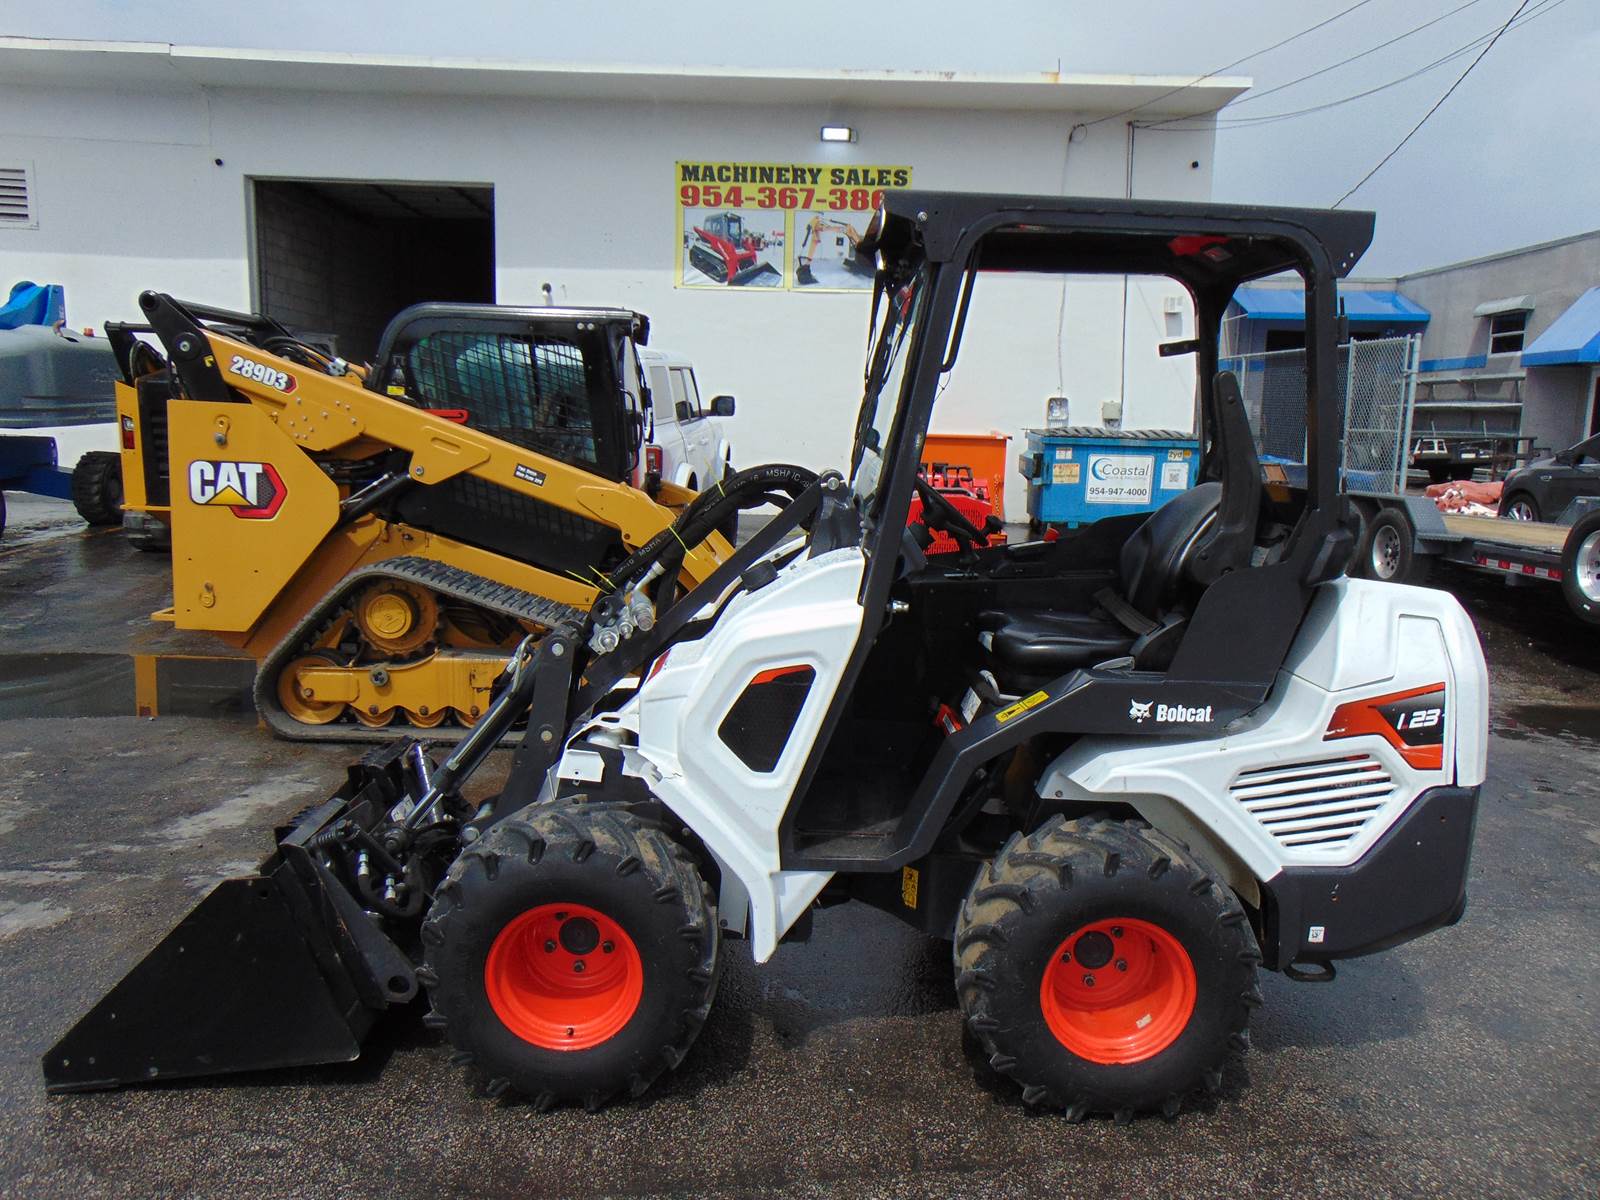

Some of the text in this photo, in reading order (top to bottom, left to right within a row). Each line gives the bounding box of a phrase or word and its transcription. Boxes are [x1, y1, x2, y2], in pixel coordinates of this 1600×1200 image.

[681, 164, 908, 187] MACHINERY SALES
[229, 356, 289, 390] 289D3
[1102, 463, 1150, 476] Coastal
[190, 460, 263, 506] CAT
[1089, 487, 1148, 496] 954-947-4000
[1156, 703, 1212, 723] Bobcat
